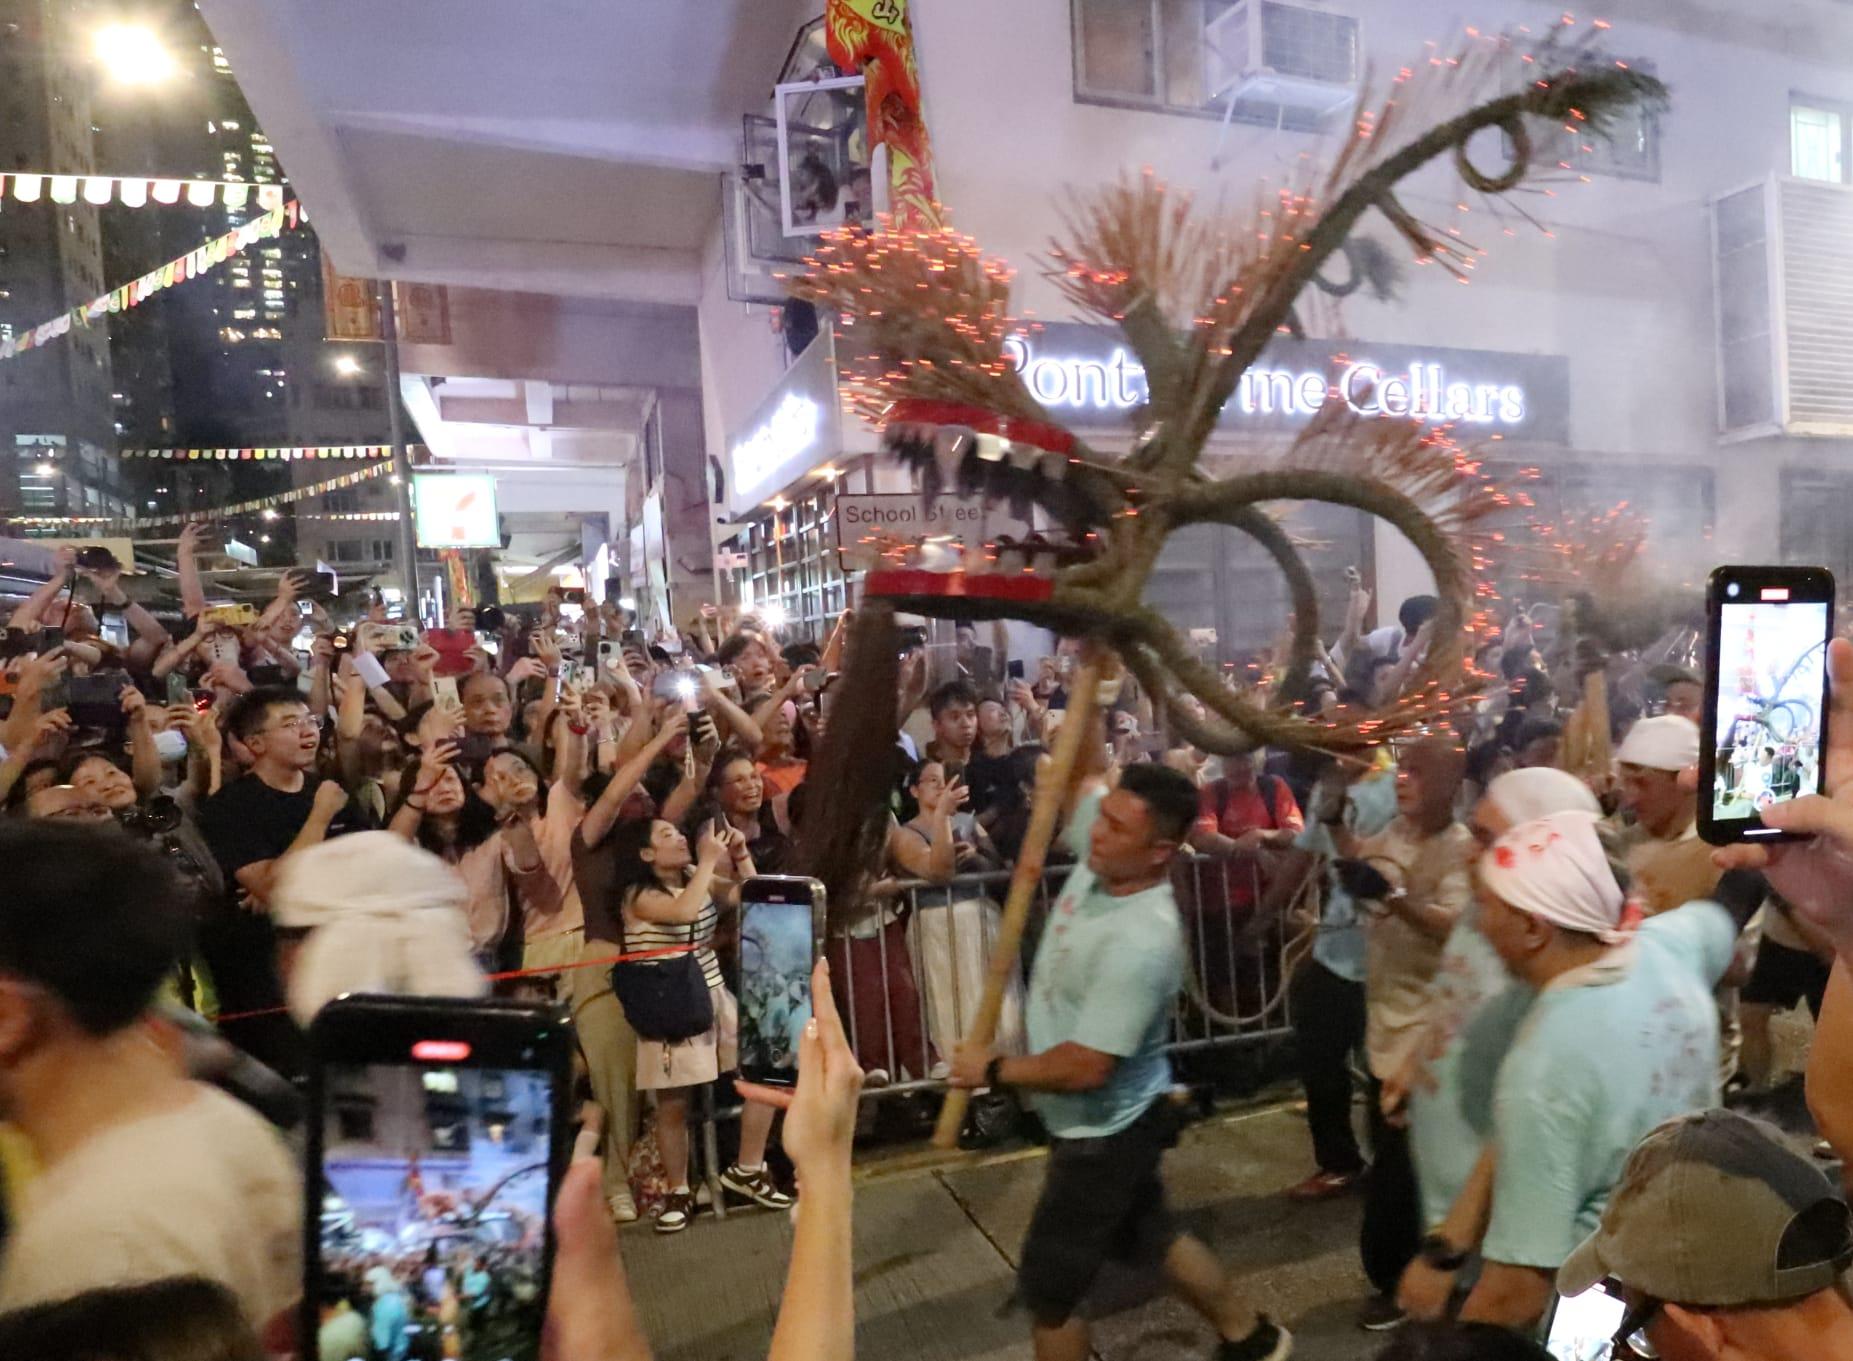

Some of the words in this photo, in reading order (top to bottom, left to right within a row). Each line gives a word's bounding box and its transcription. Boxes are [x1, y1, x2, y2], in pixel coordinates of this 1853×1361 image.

[1002, 335, 1150, 407] ont
[1240, 366, 1328, 415] ine
[1340, 361, 1525, 423] Cellars
[846, 504, 916, 524] School
[925, 503, 986, 522] Stee
